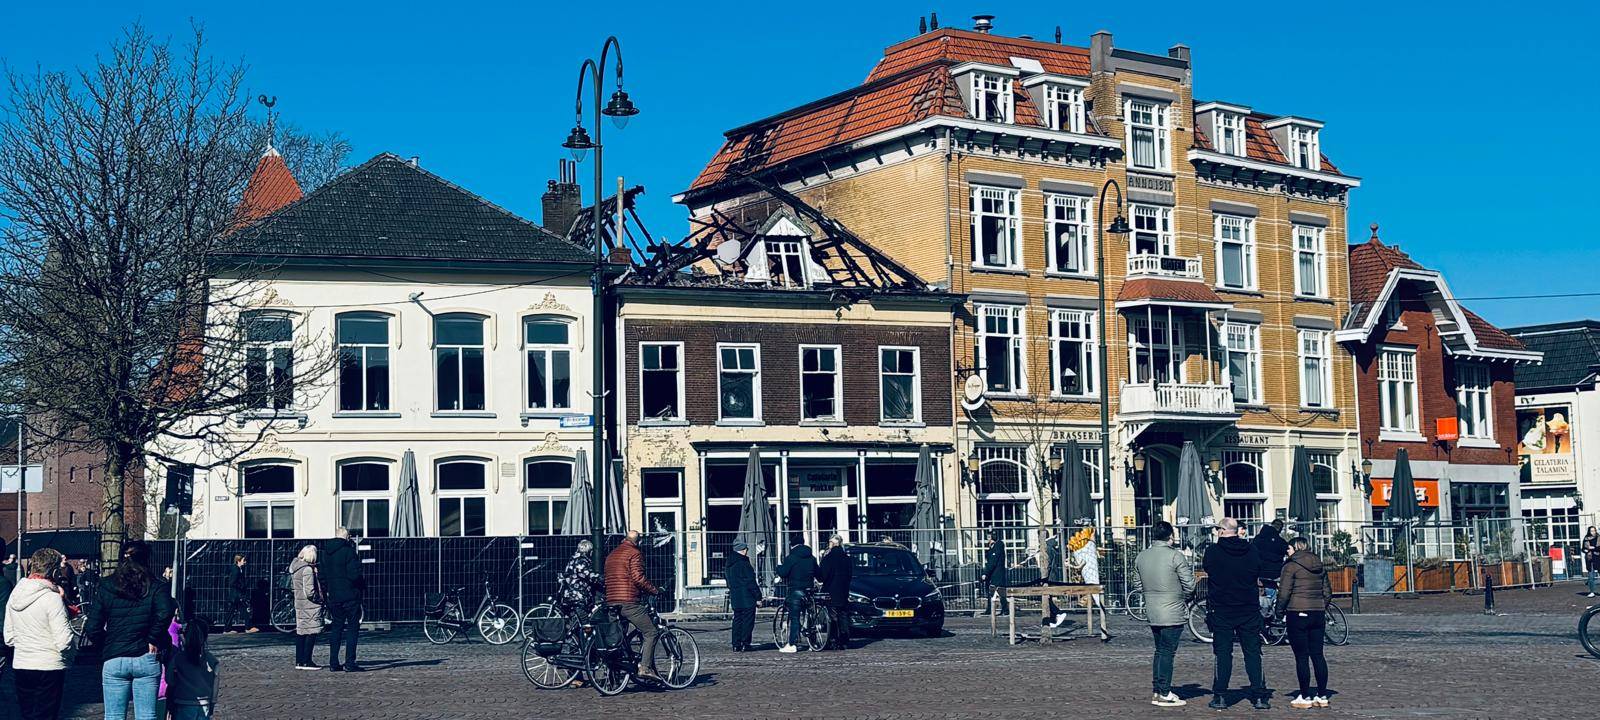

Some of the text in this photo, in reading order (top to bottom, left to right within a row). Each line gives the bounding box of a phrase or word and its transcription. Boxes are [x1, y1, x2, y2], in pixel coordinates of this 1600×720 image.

[1128, 175, 1153, 190] ANNO
[1224, 435, 1269, 444] RESTAURANT
[1536, 466, 1568, 474] TALAMINI
